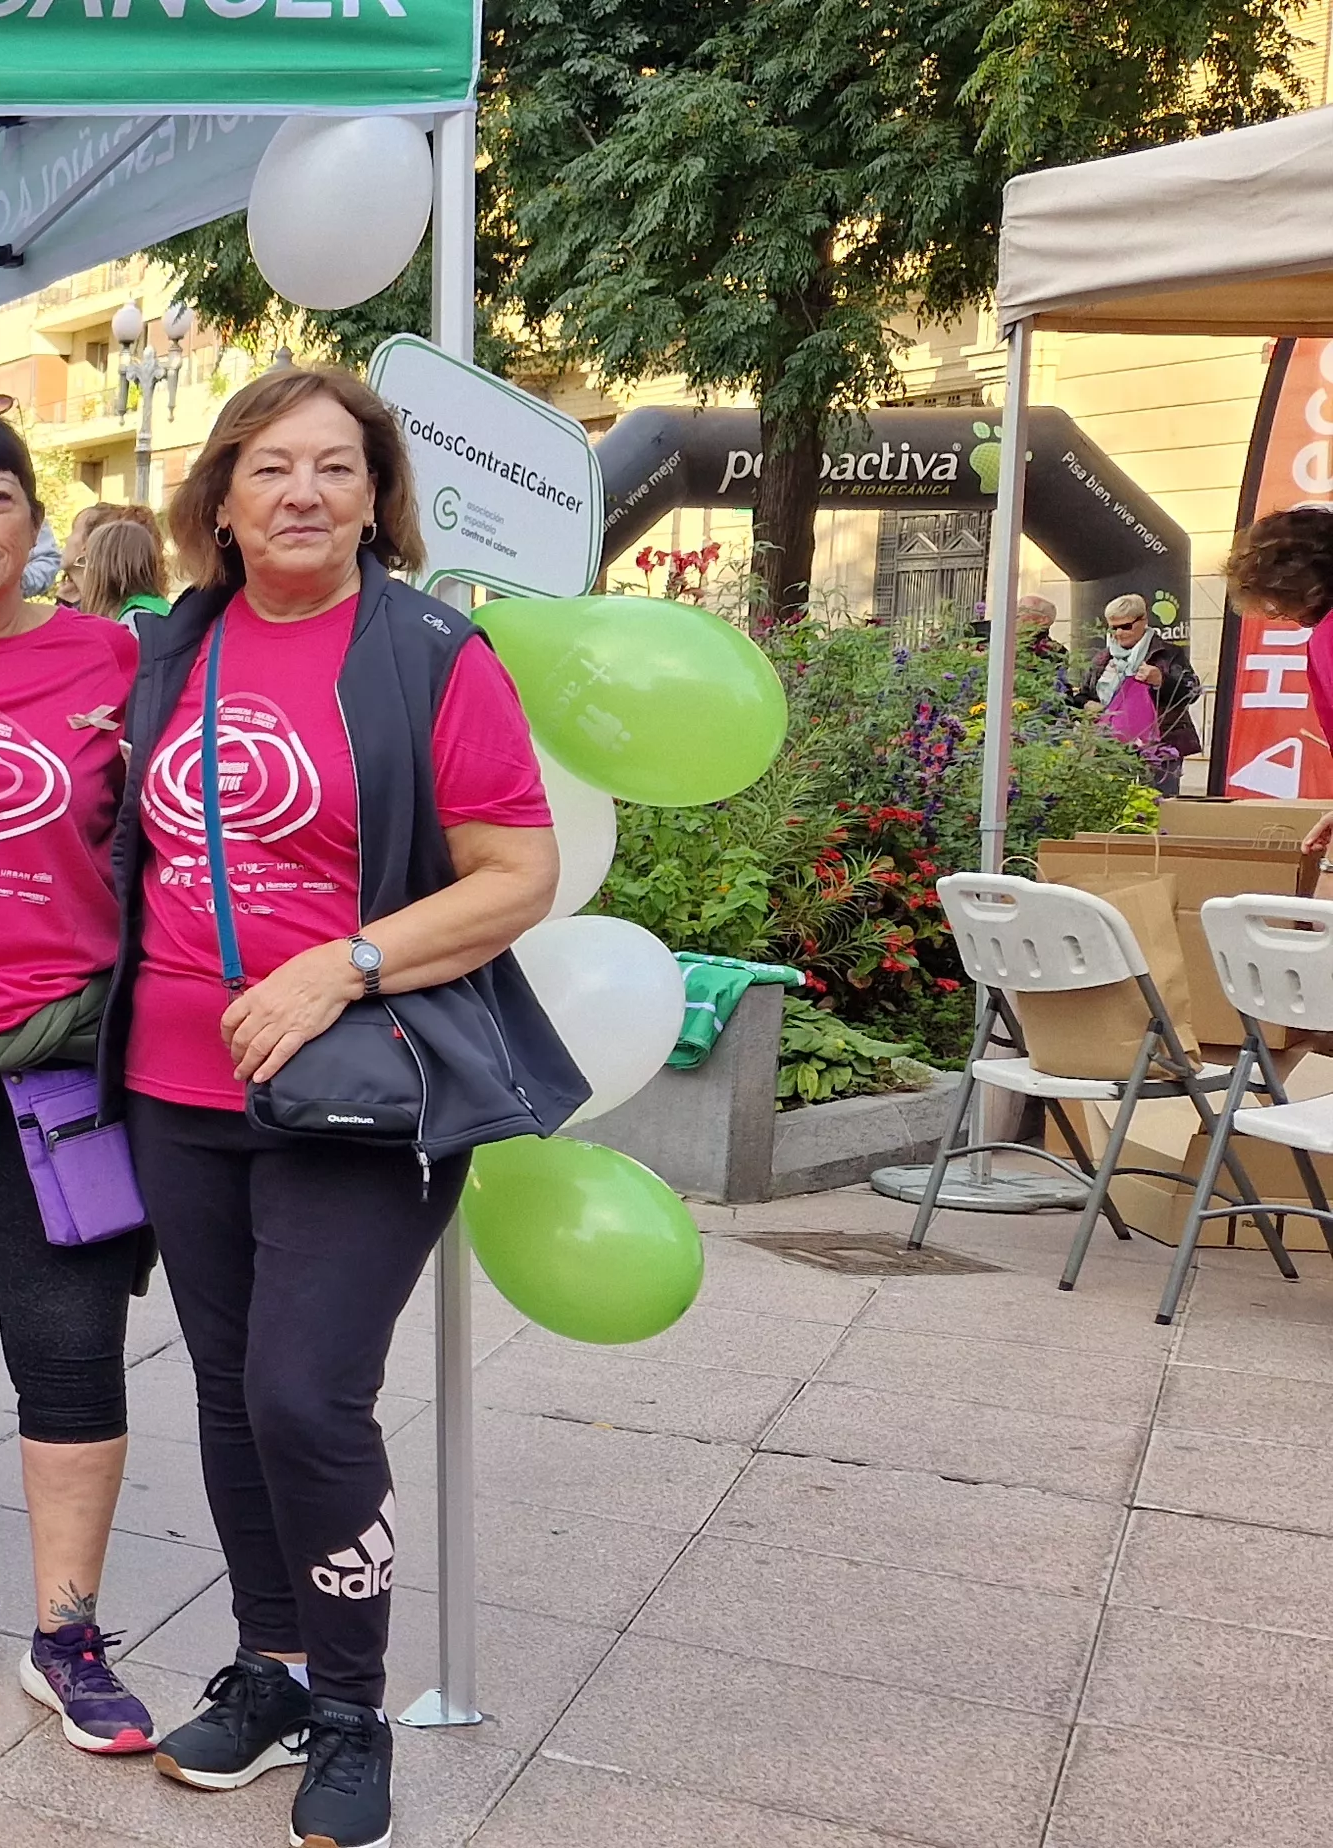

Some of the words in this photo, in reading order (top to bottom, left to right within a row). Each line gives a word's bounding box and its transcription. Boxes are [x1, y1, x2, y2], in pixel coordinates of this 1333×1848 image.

[625, 480, 650, 509] vive
[648, 449, 683, 484] mejor
[718, 442, 958, 494] pactiva
[838, 485, 847, 495] Y
[852, 483, 950, 495] BIOMECÁNICA
[1061, 450, 1087, 481] Pisa
[1085, 474, 1112, 507] bien,
[1112, 499, 1136, 526] vive
[1133, 521, 1169, 556] mejor
[461, 526, 485, 544] contra
[493, 539, 518, 559] cáncer
[422, 613, 452, 636] CMP
[327, 1113, 374, 1124] Quechua
[310, 1562, 393, 1600] adi
